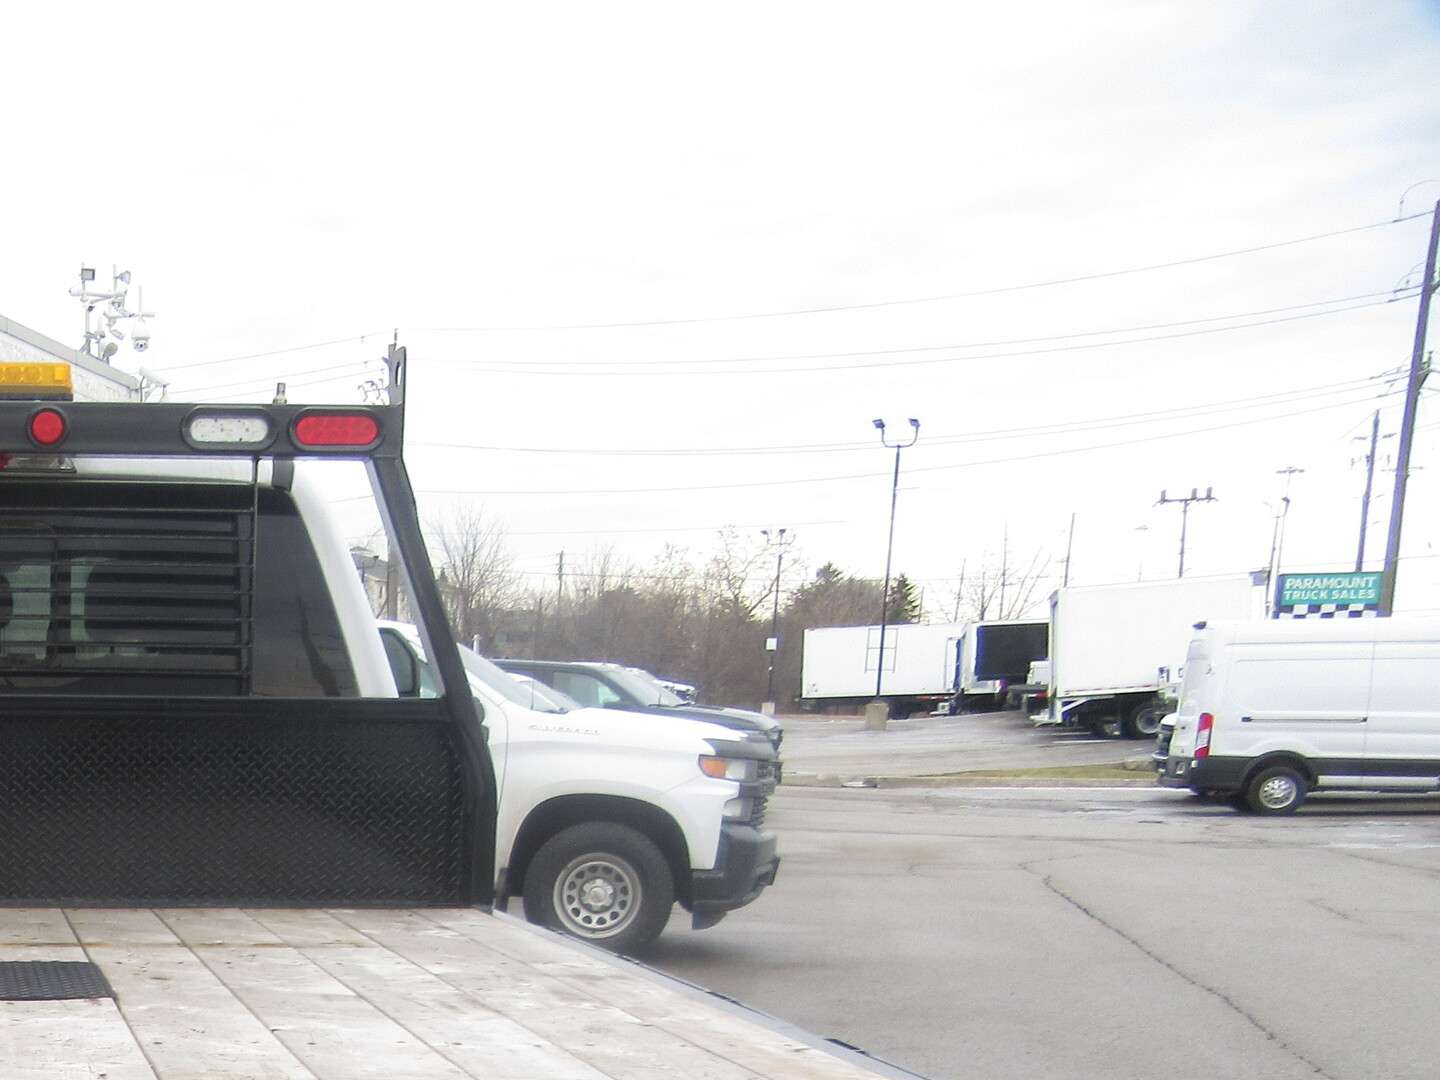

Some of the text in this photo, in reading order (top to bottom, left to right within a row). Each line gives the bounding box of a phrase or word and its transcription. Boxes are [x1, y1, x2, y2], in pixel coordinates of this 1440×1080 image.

[1285, 576, 1376, 590] PARAMOUNT
[1283, 589, 1376, 600] TRUCK SALES
